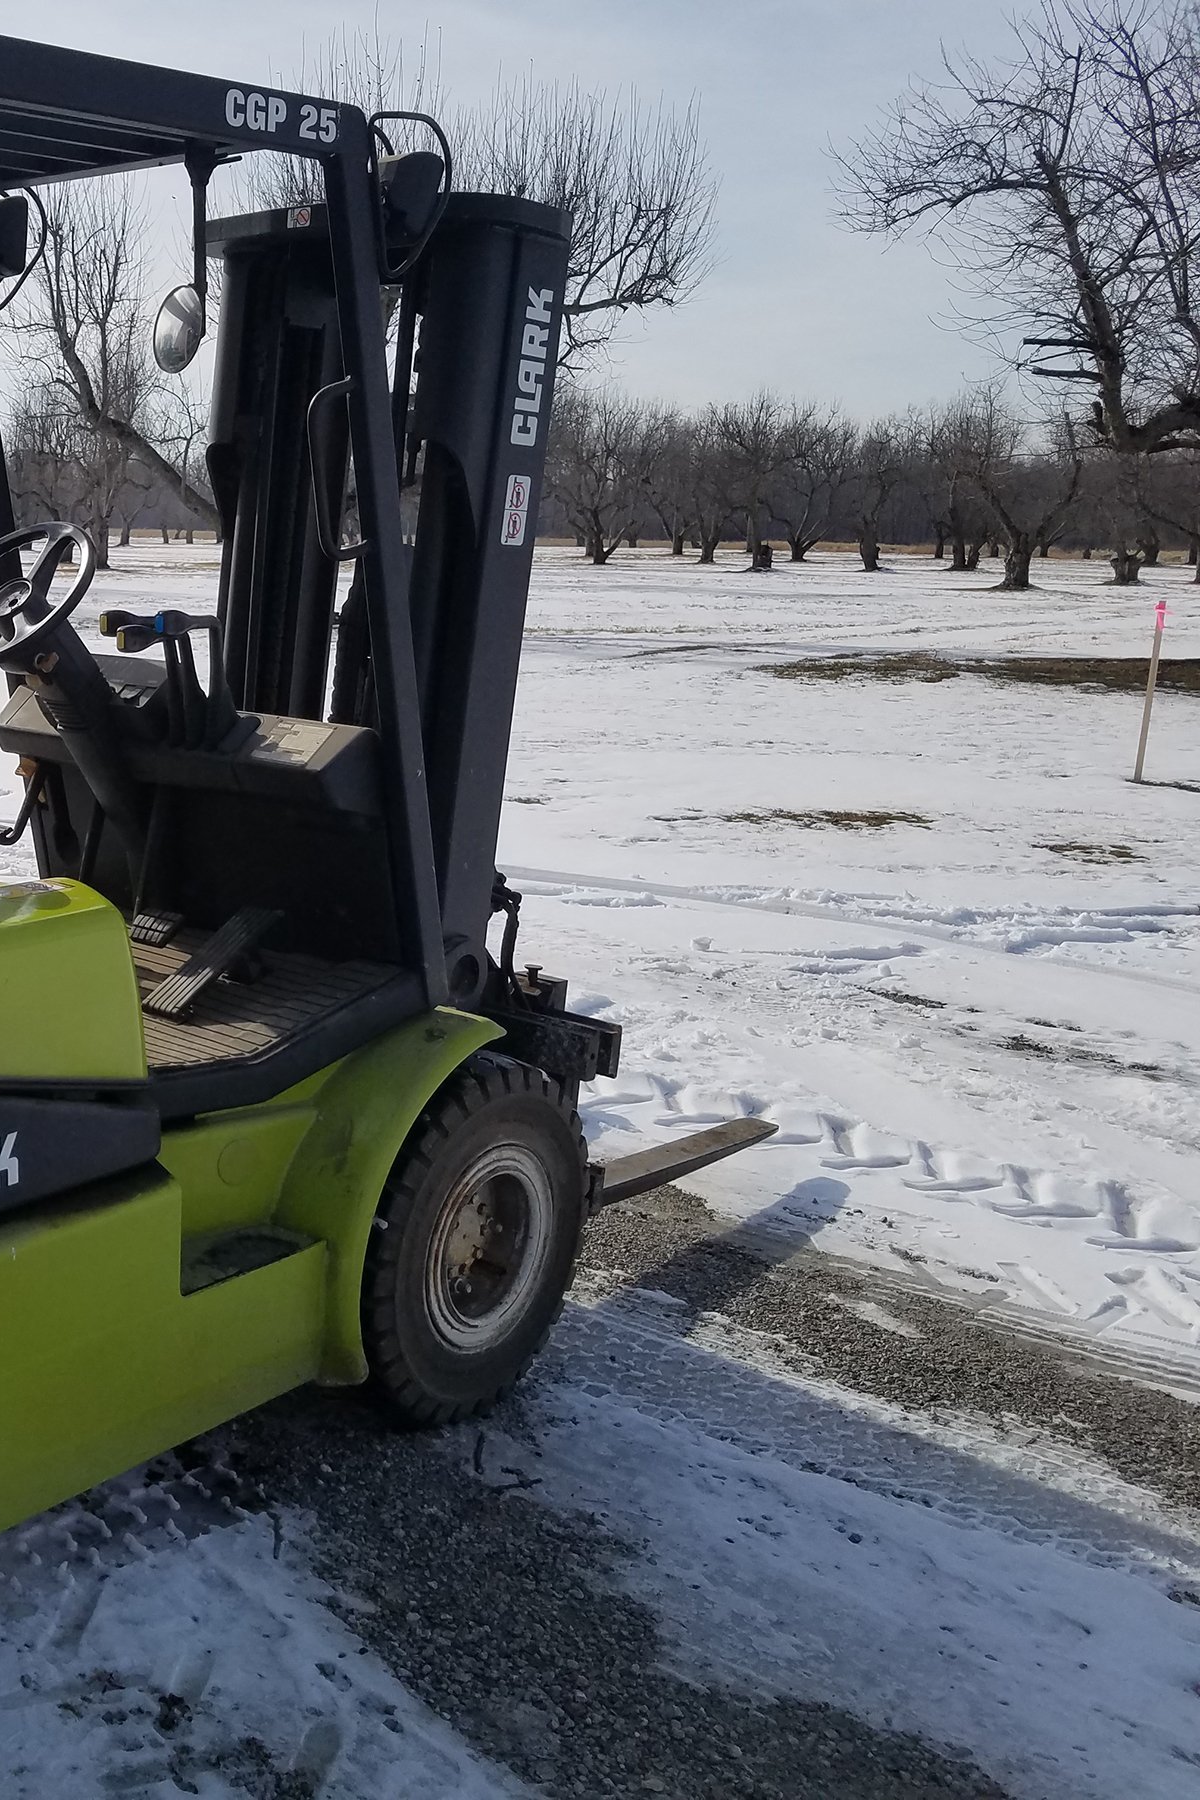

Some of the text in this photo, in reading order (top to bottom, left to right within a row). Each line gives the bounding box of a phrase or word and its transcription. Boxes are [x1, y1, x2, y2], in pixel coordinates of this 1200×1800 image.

[225, 88, 337, 143] CGP 25
[510, 285, 554, 447] CLARK
